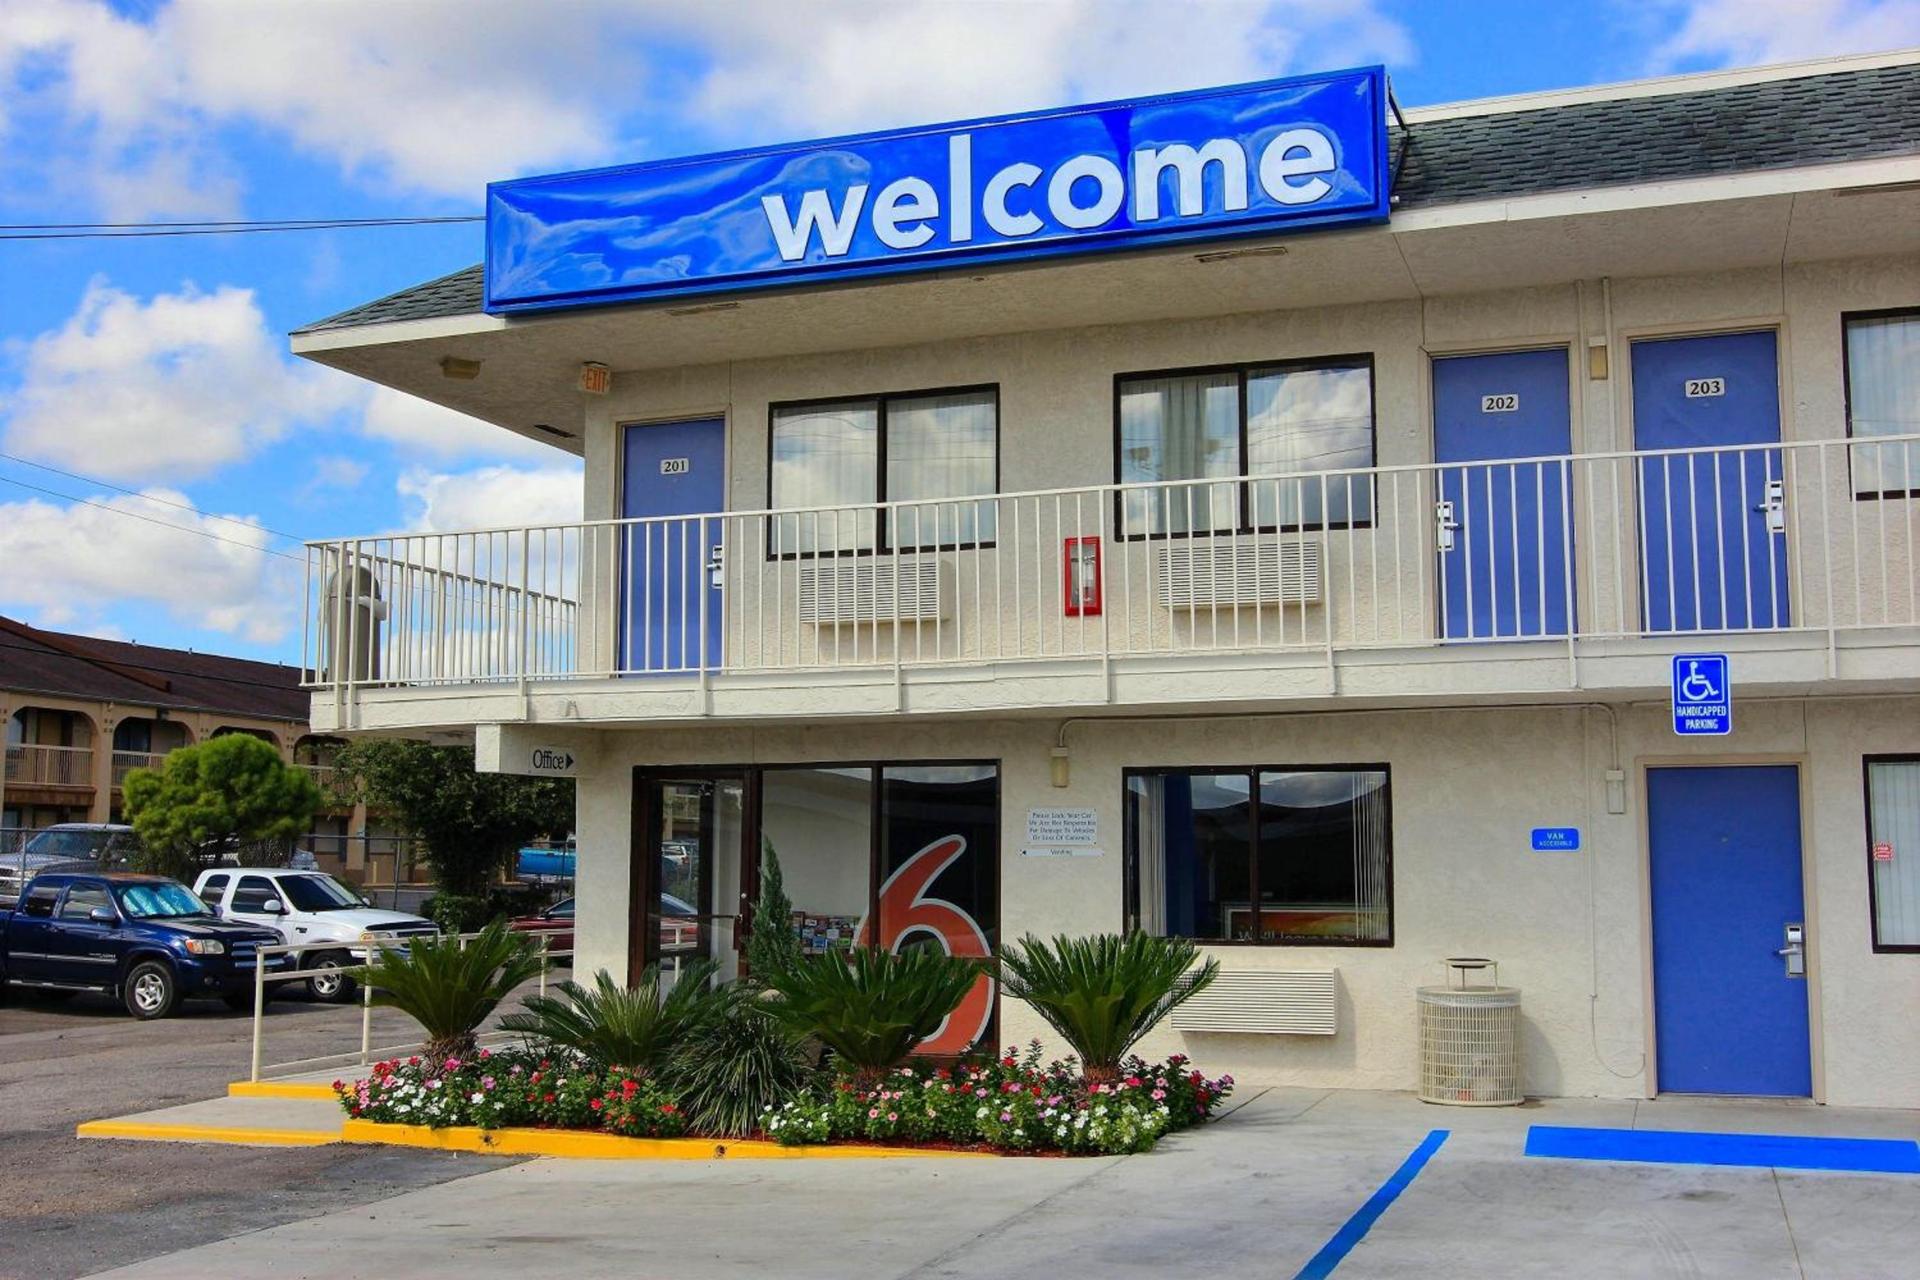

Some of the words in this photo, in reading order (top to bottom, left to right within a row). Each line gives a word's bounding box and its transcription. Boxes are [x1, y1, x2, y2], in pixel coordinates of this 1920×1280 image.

[761, 128, 1335, 262] welcome
[586, 367, 606, 393] EXIT
[1689, 380, 1721, 396] 203
[1485, 395, 1515, 411] 202
[663, 460, 685, 473] 201
[1676, 705, 1727, 717] HANDICAPPED
[1685, 718, 1719, 730] PARKING
[532, 749, 564, 770] Office
[1546, 831, 1564, 840] VAN
[850, 834, 996, 1056] 6
